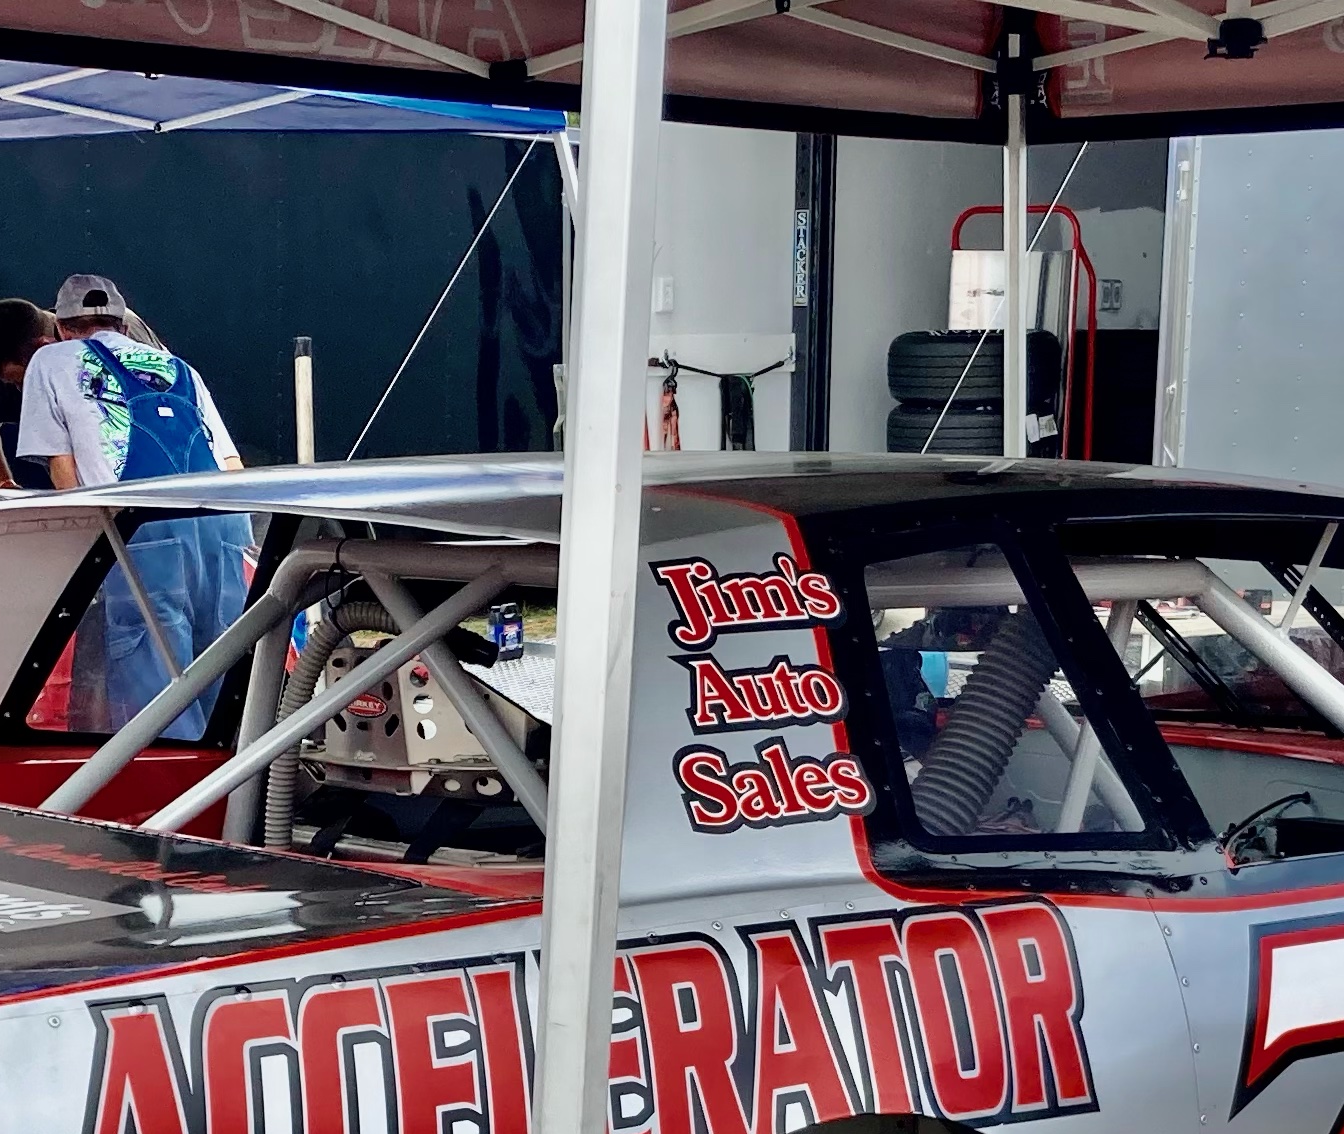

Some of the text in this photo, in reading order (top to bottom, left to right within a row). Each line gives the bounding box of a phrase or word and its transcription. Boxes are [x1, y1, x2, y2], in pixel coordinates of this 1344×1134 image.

[796, 212, 807, 298] STACKER
[658, 555, 840, 645] Jim's
[689, 658, 842, 727] Auto
[679, 744, 870, 825] Sales
